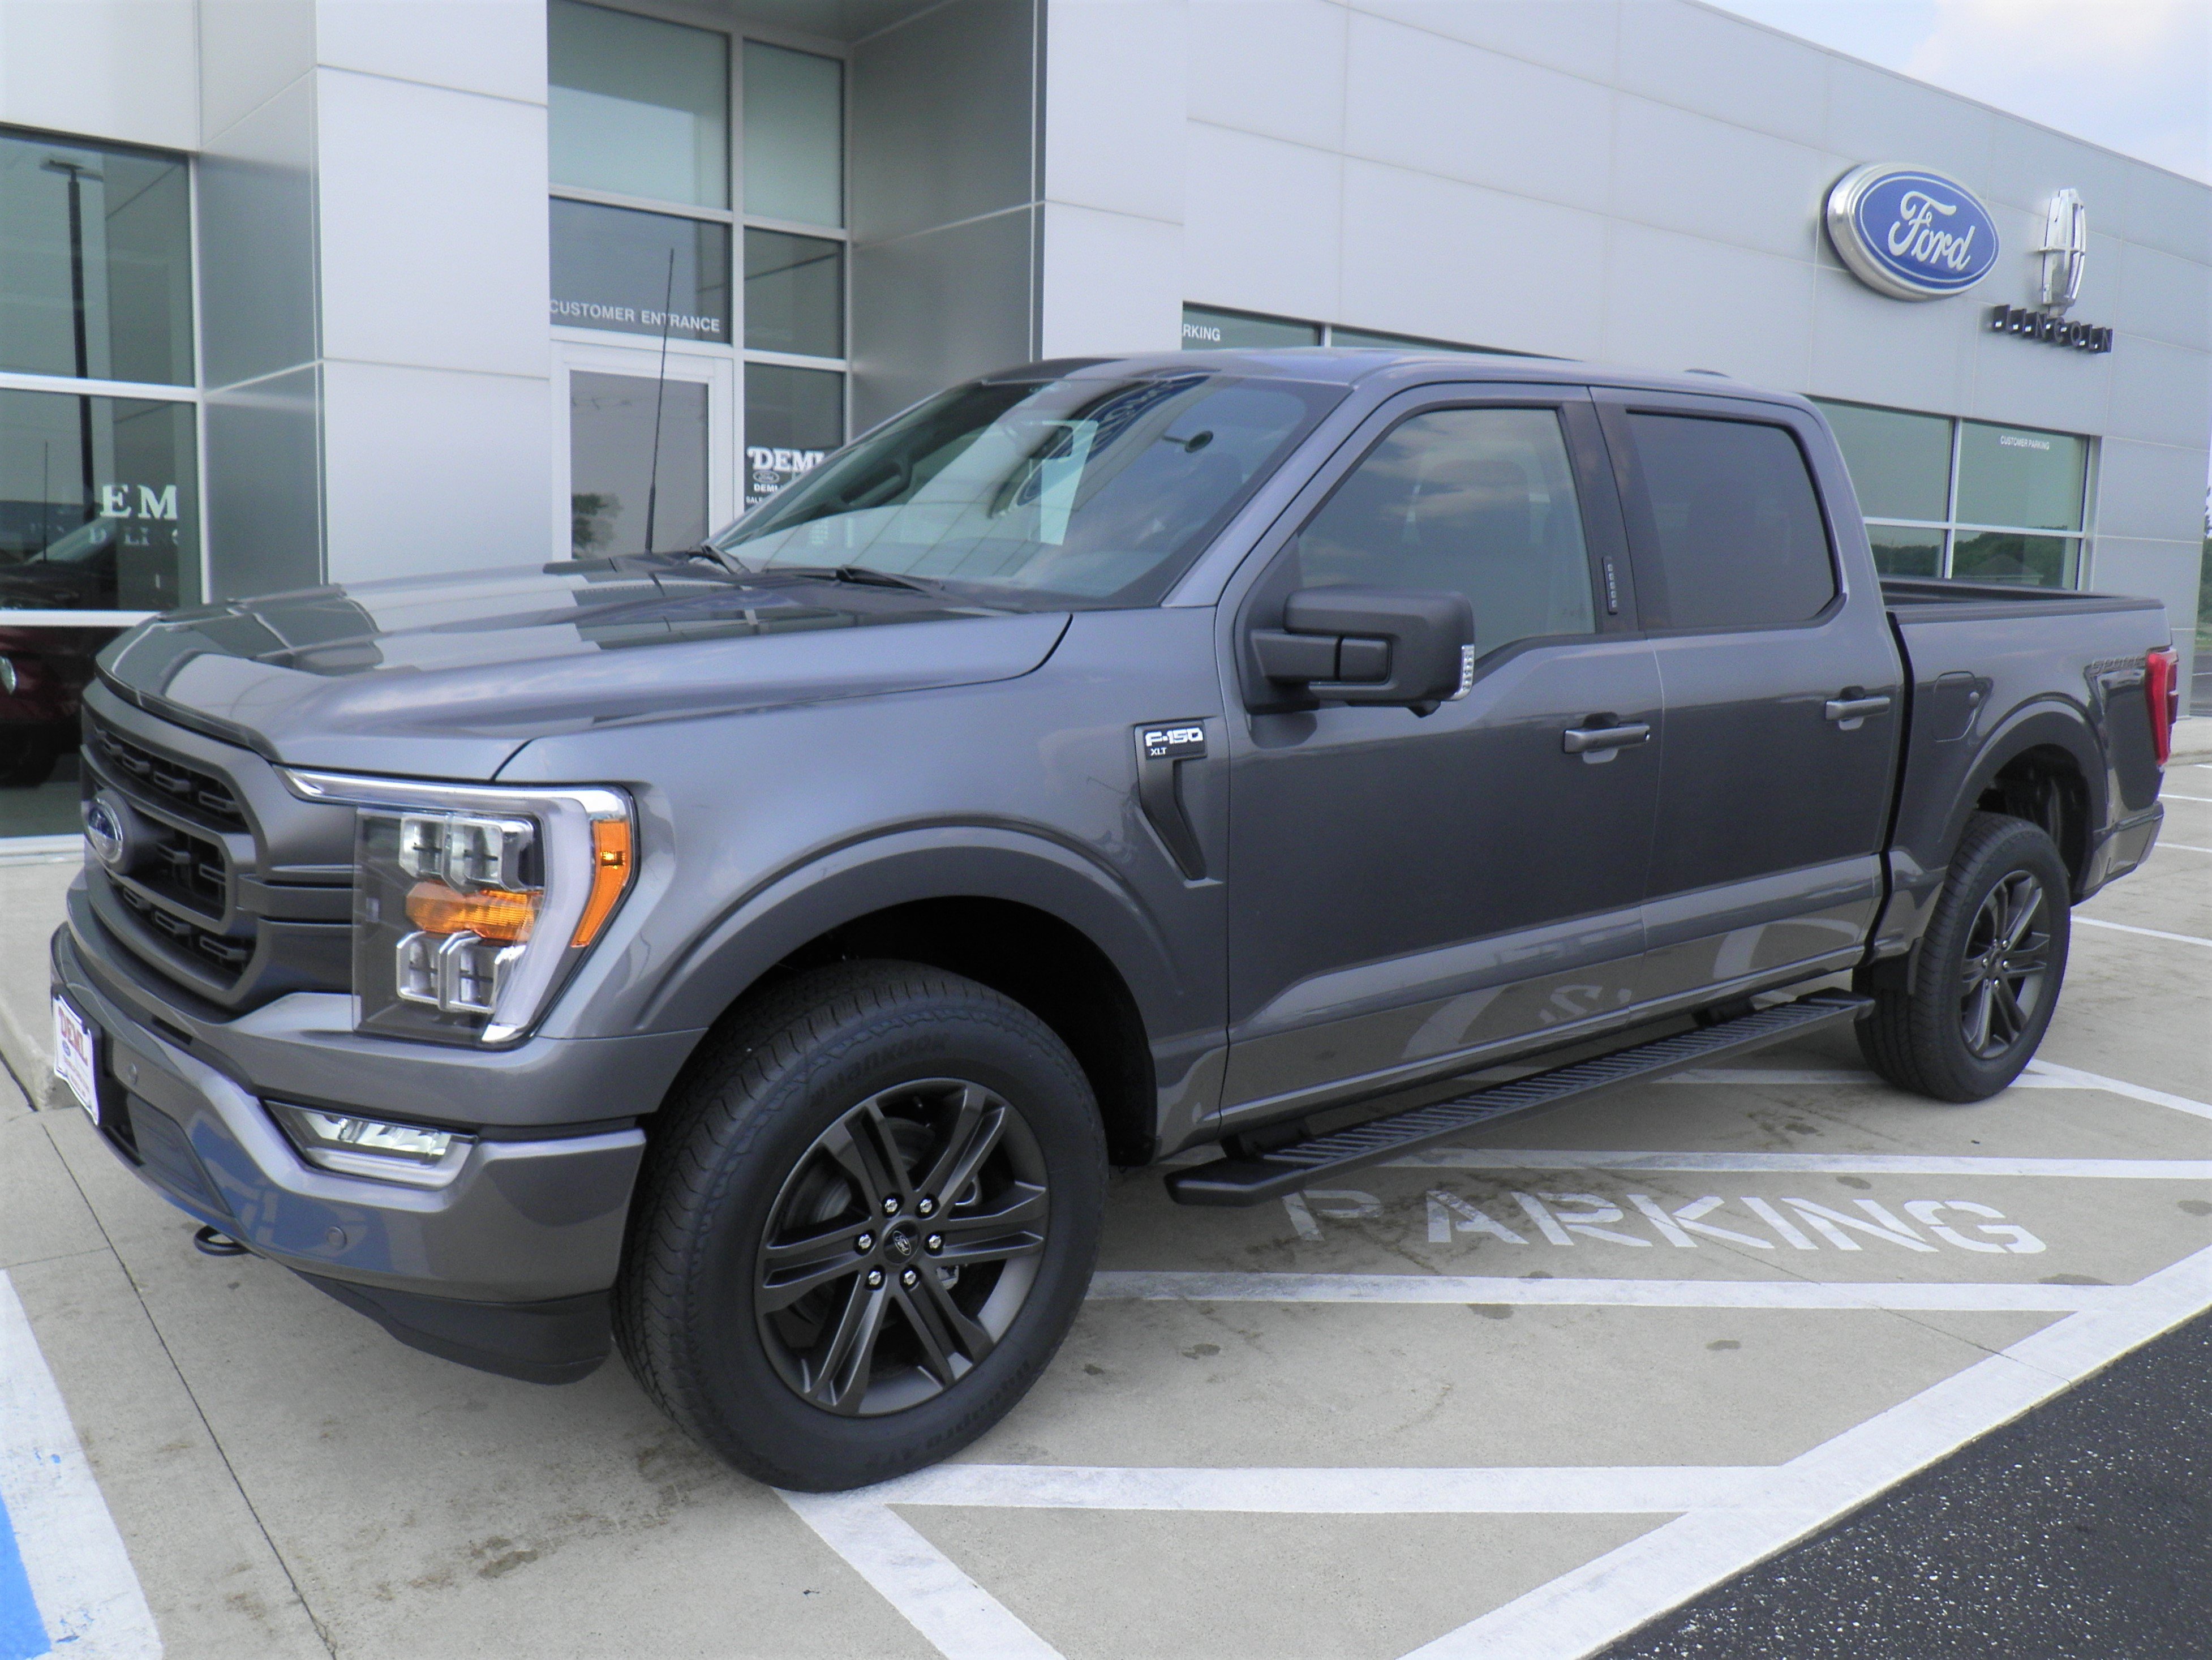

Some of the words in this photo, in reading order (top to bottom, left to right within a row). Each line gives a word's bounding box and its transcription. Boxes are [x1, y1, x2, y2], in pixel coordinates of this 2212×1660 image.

[1888, 191, 1975, 271] Ford
[549, 299, 634, 322] CUSTOMER
[641, 310, 720, 332] ENTRANCE
[1183, 323, 1221, 341] RKING
[2000, 435, 2028, 448] CUSTOMER
[2028, 439, 2050, 451] PARKING
[1145, 727, 1203, 747] F-150
[1150, 747, 1167, 756] XLT
[1281, 1190, 2046, 1254] PARKING
